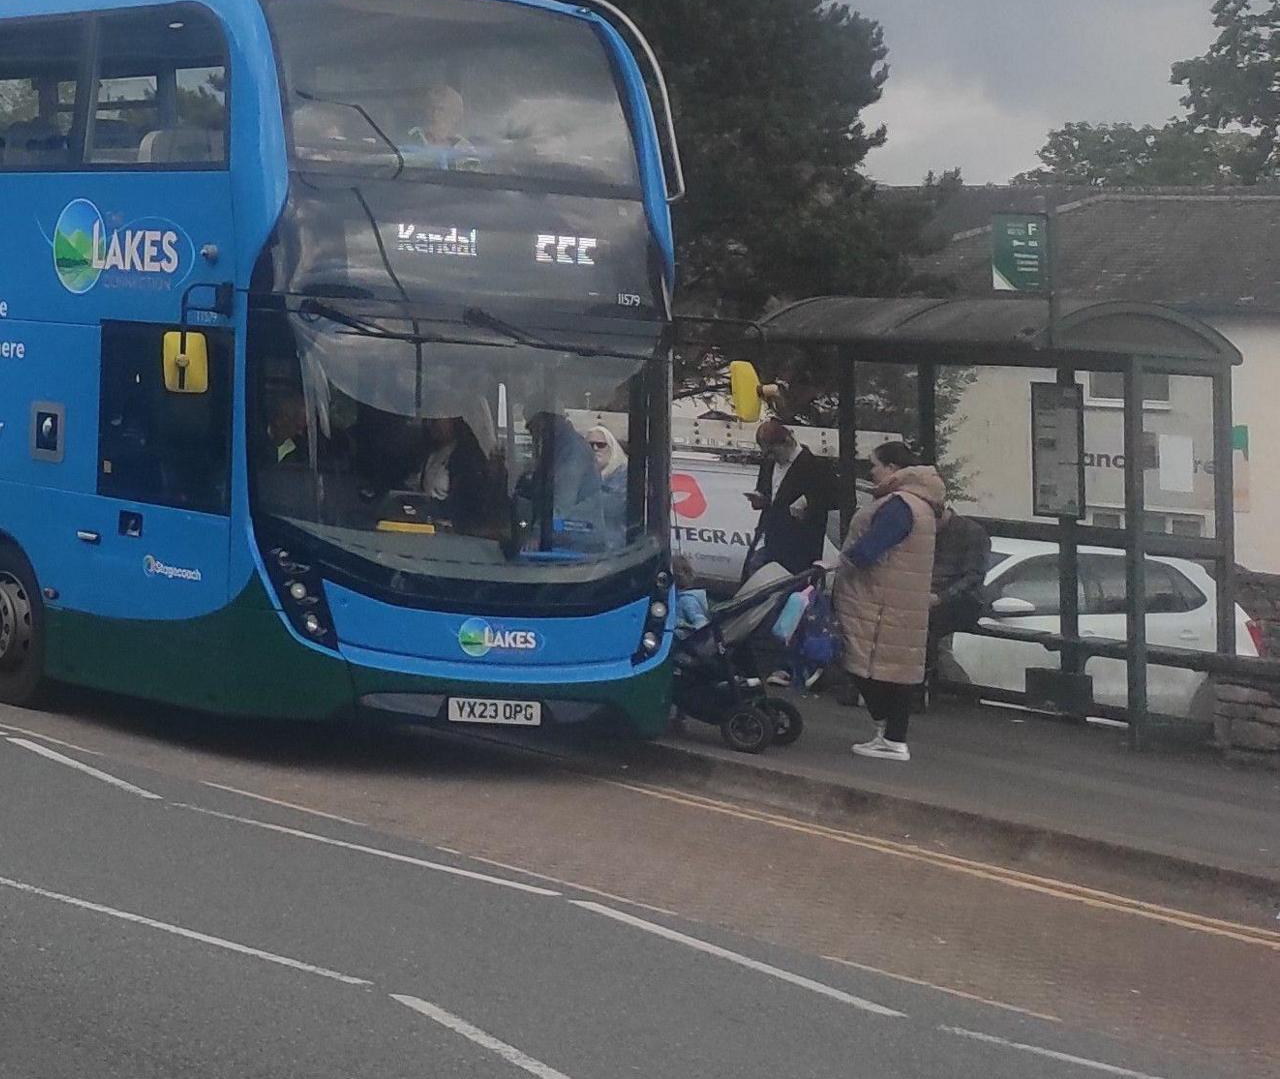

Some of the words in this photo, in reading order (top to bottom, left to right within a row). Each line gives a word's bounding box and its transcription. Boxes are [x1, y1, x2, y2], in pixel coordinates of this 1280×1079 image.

[397, 223, 477, 256] Kendal
[1028, 223, 1038, 236] F
[92, 218, 179, 273] LAKES
[617, 293, 641, 307] 11579
[484, 626, 537, 649] LAKES
[456, 700, 499, 719] YX23
[503, 703, 534, 721] OPG
